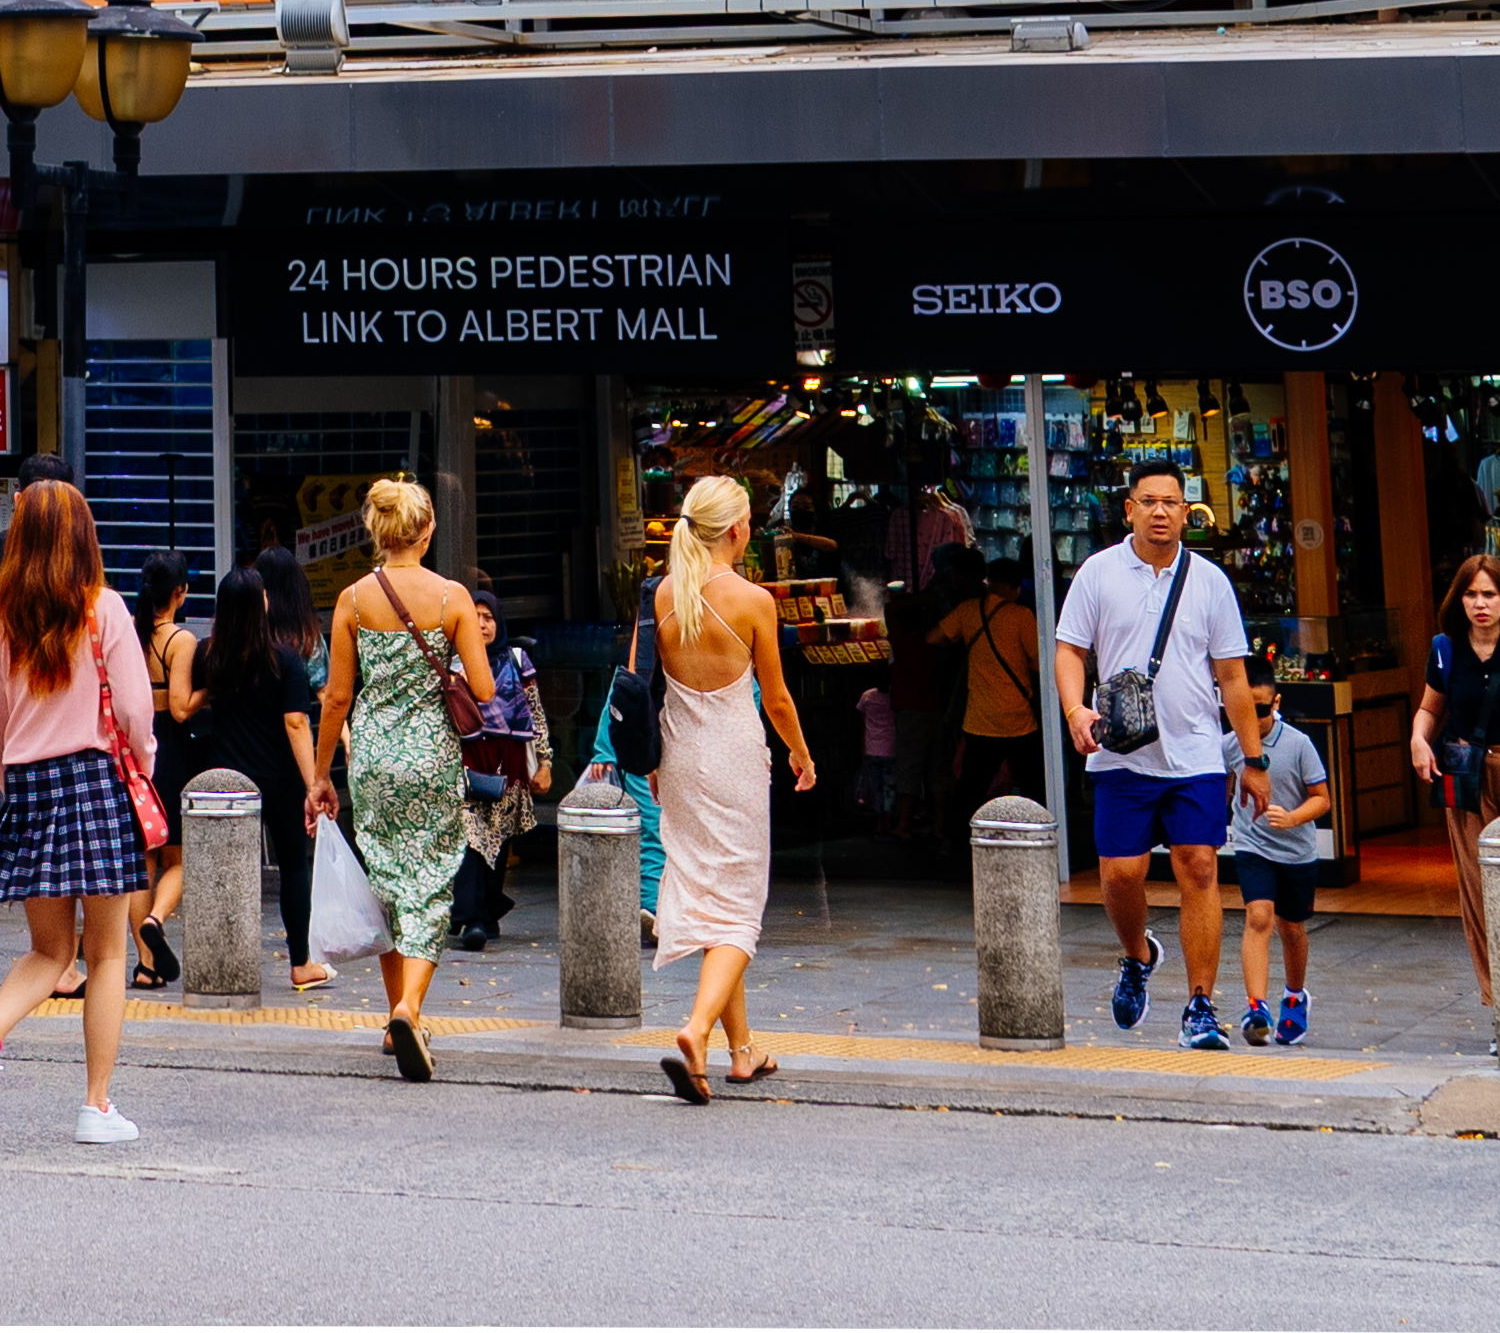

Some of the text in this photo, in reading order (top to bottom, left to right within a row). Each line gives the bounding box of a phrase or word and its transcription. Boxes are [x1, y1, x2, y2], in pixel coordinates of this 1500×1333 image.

[287, 252, 732, 292] 24 HOURS PEDESTRIAN
[911, 281, 1062, 315] SEIKO
[1260, 278, 1341, 310] BSO
[302, 306, 718, 344] LINK TO ALBERT MALL
